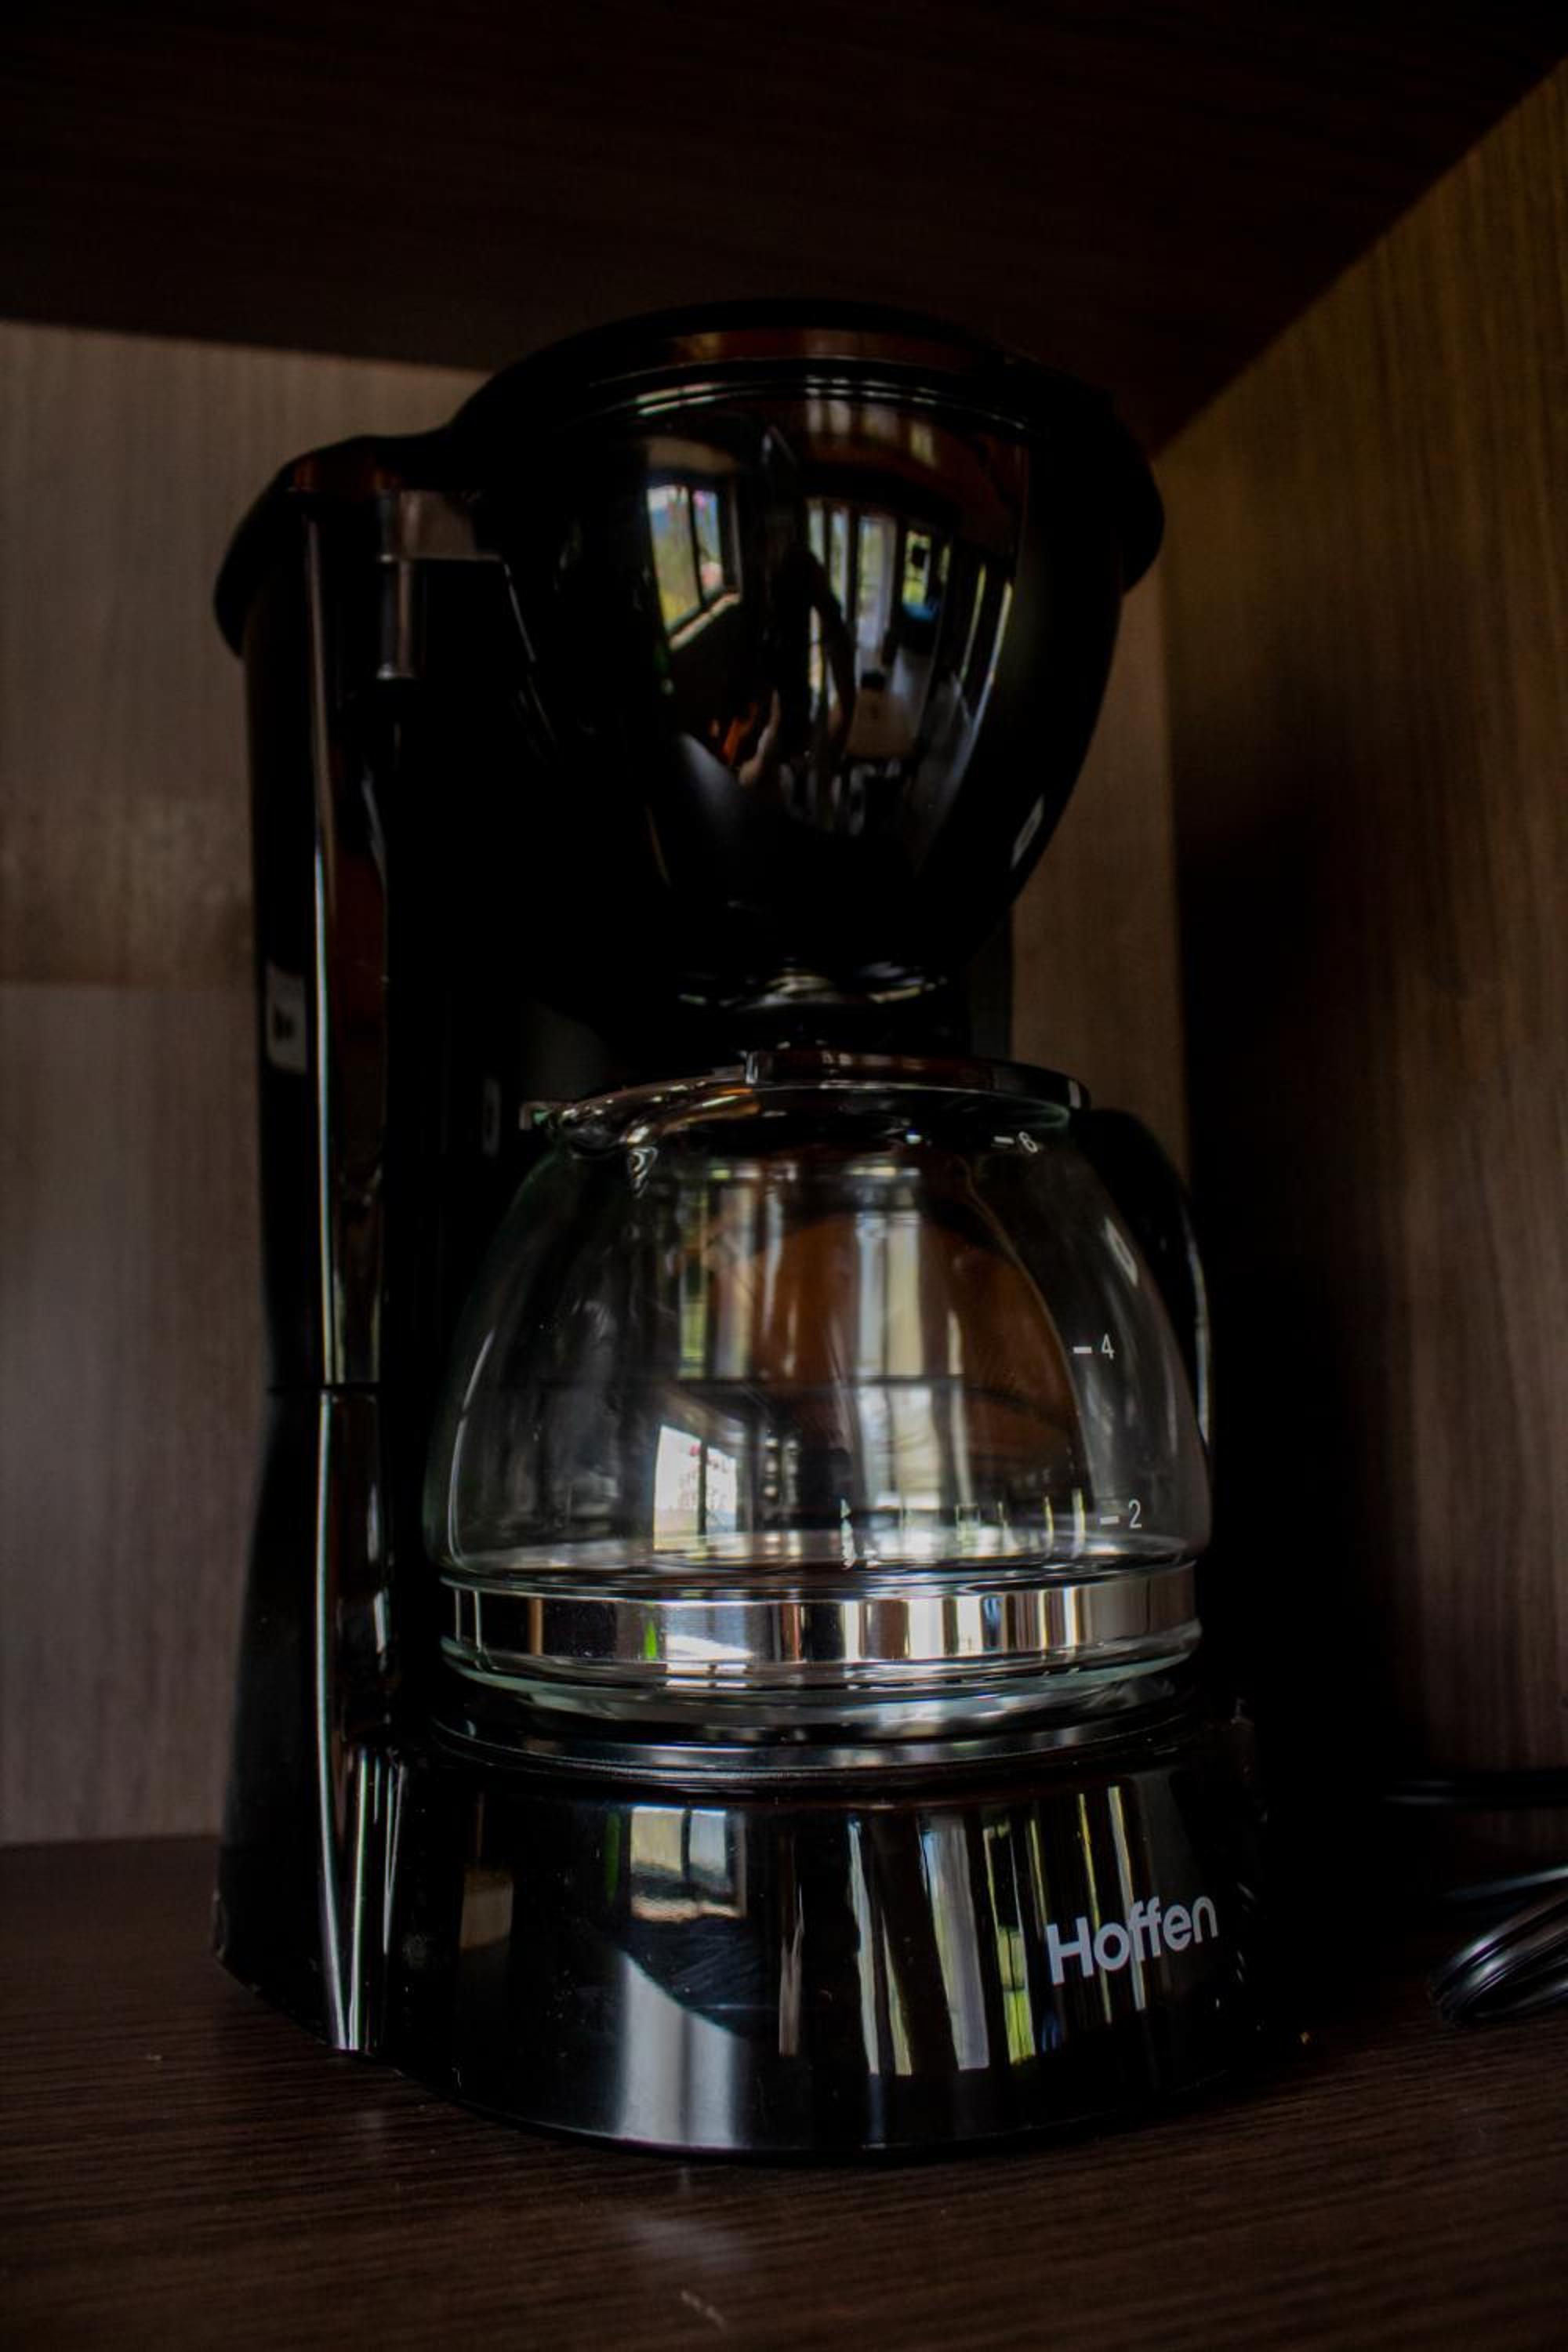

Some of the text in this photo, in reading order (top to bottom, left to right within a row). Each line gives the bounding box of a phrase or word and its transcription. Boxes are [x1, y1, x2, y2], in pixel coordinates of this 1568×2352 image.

[1102, 1333, 1115, 1359] 4
[1128, 1499, 1142, 1528] 2
[1047, 1895, 1220, 1985] Hoffen
